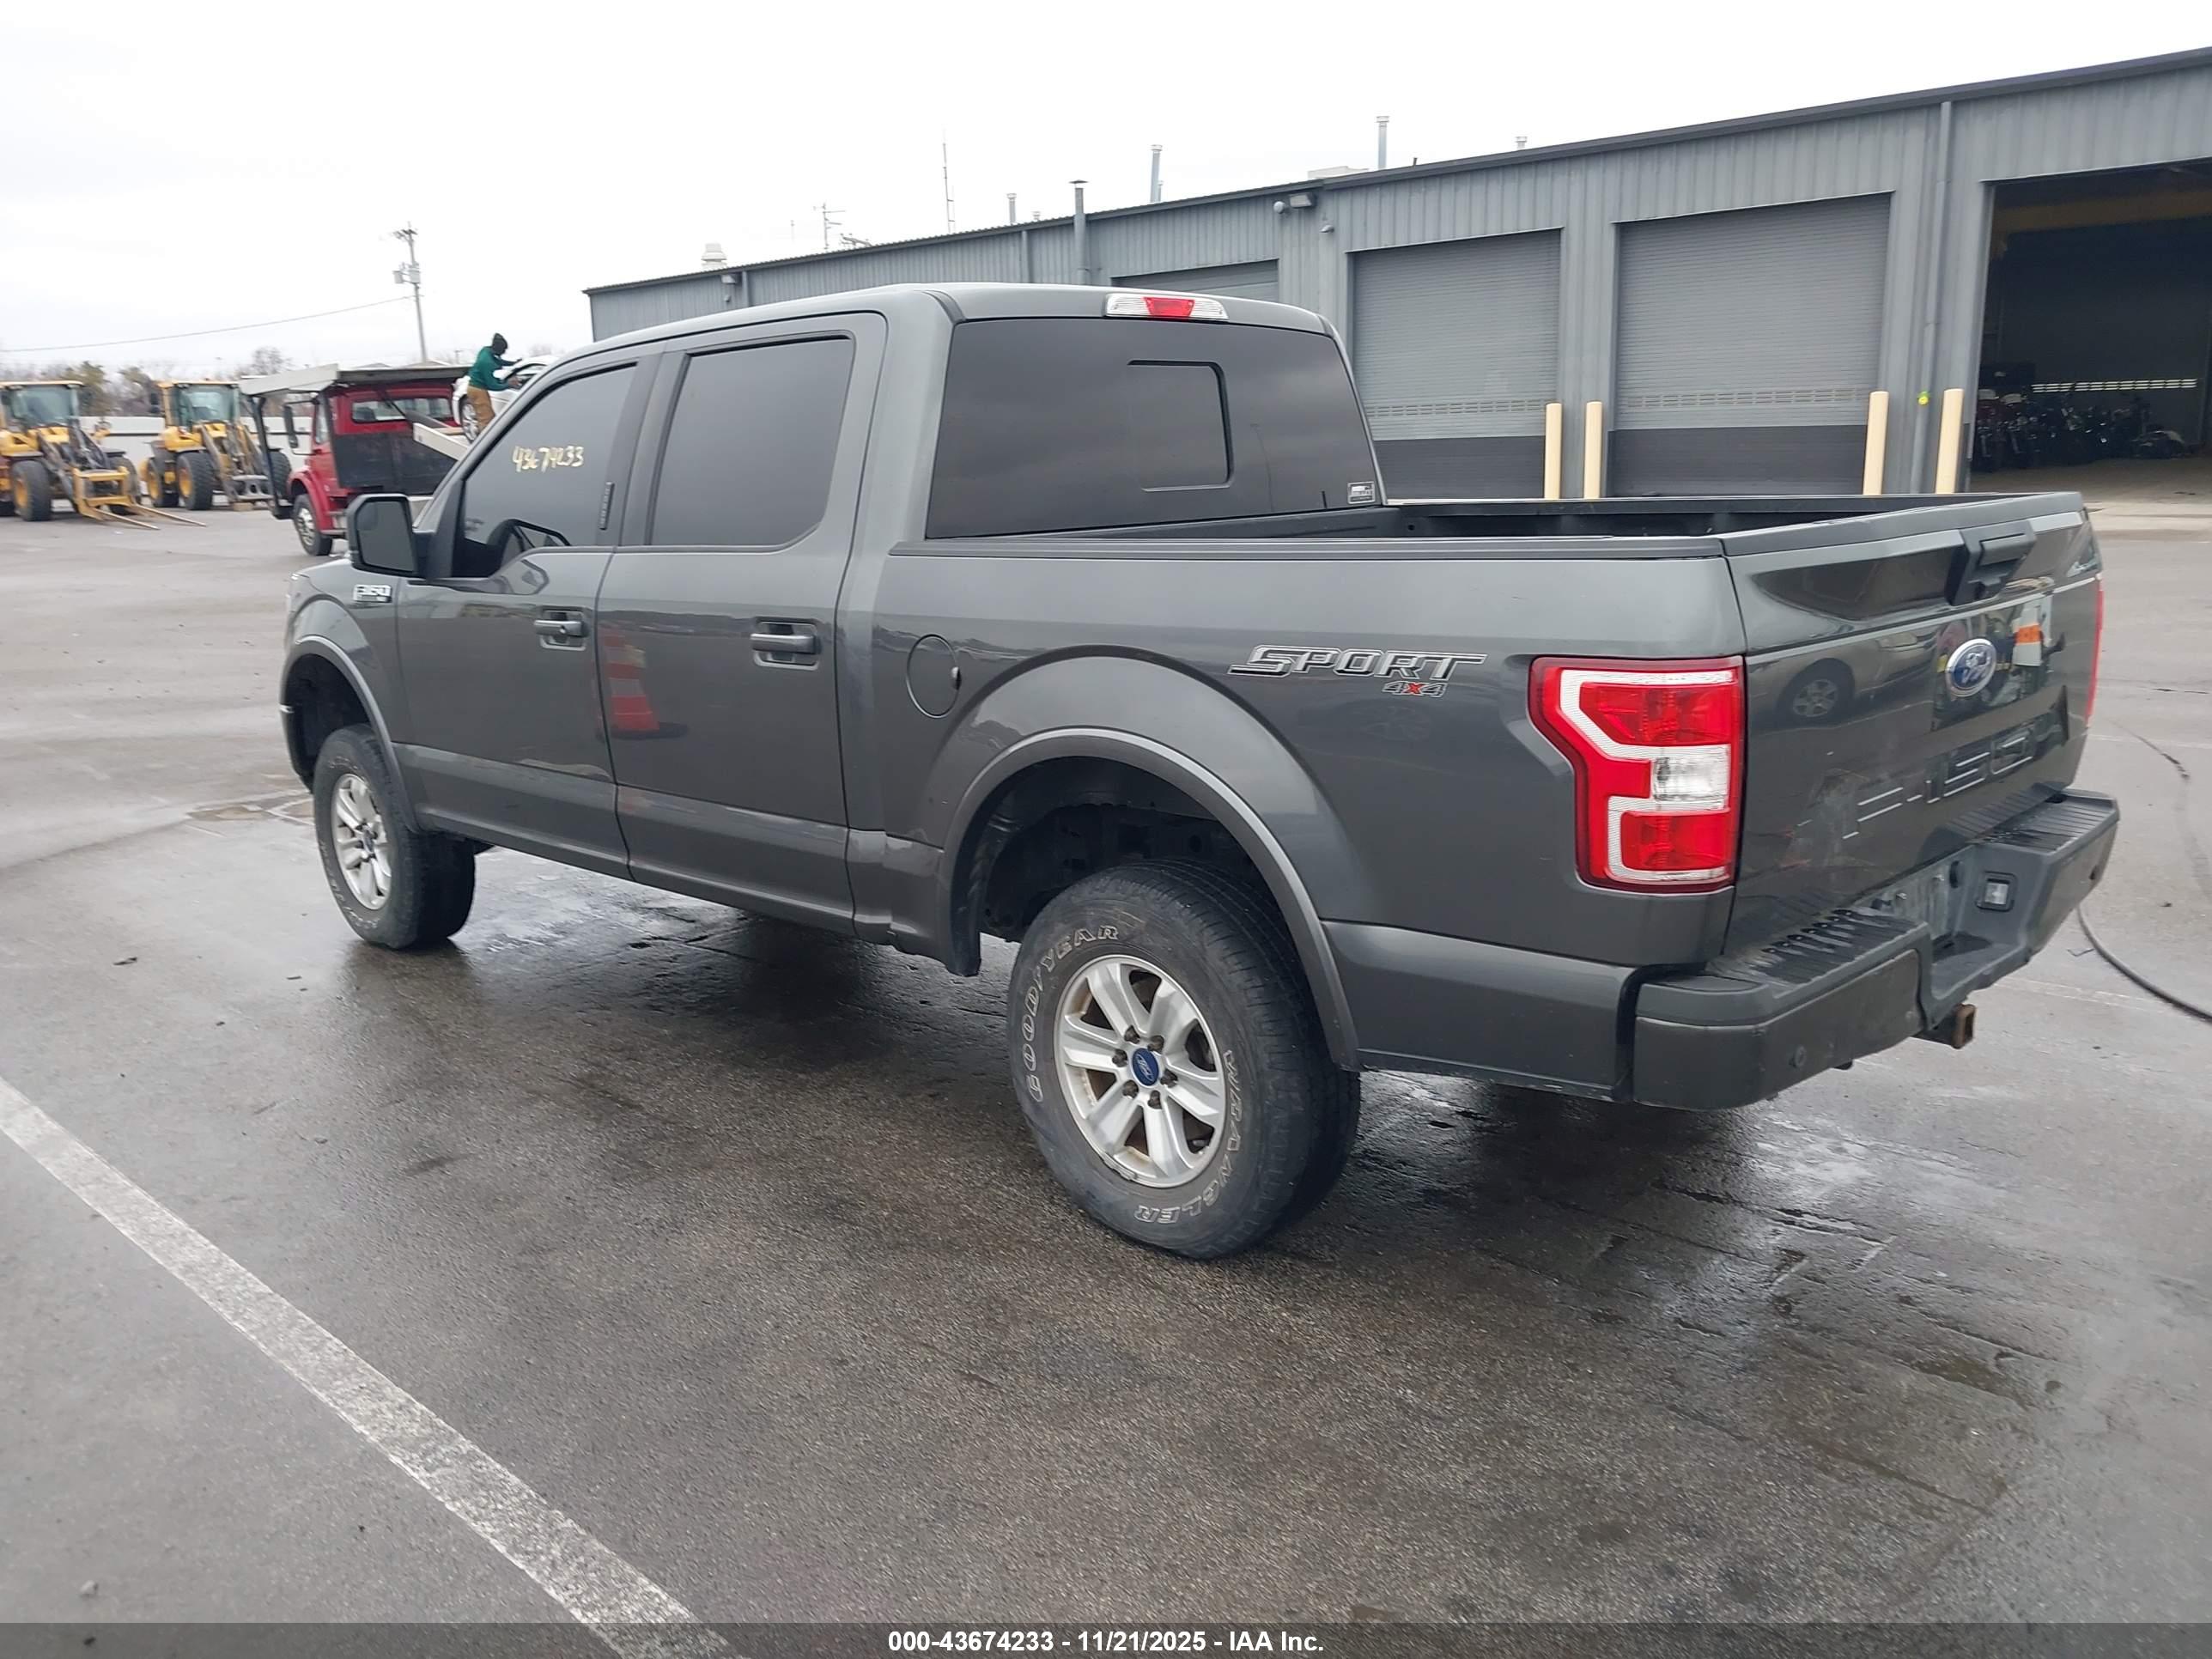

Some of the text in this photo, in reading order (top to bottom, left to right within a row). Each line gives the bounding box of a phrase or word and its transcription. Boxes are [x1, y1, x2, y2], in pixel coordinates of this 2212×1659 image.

[1228, 645, 1488, 681] SPORT
[1022, 924, 1119, 1103] GOODYEAR
[1133, 1049, 1243, 1224] WRANGLER
